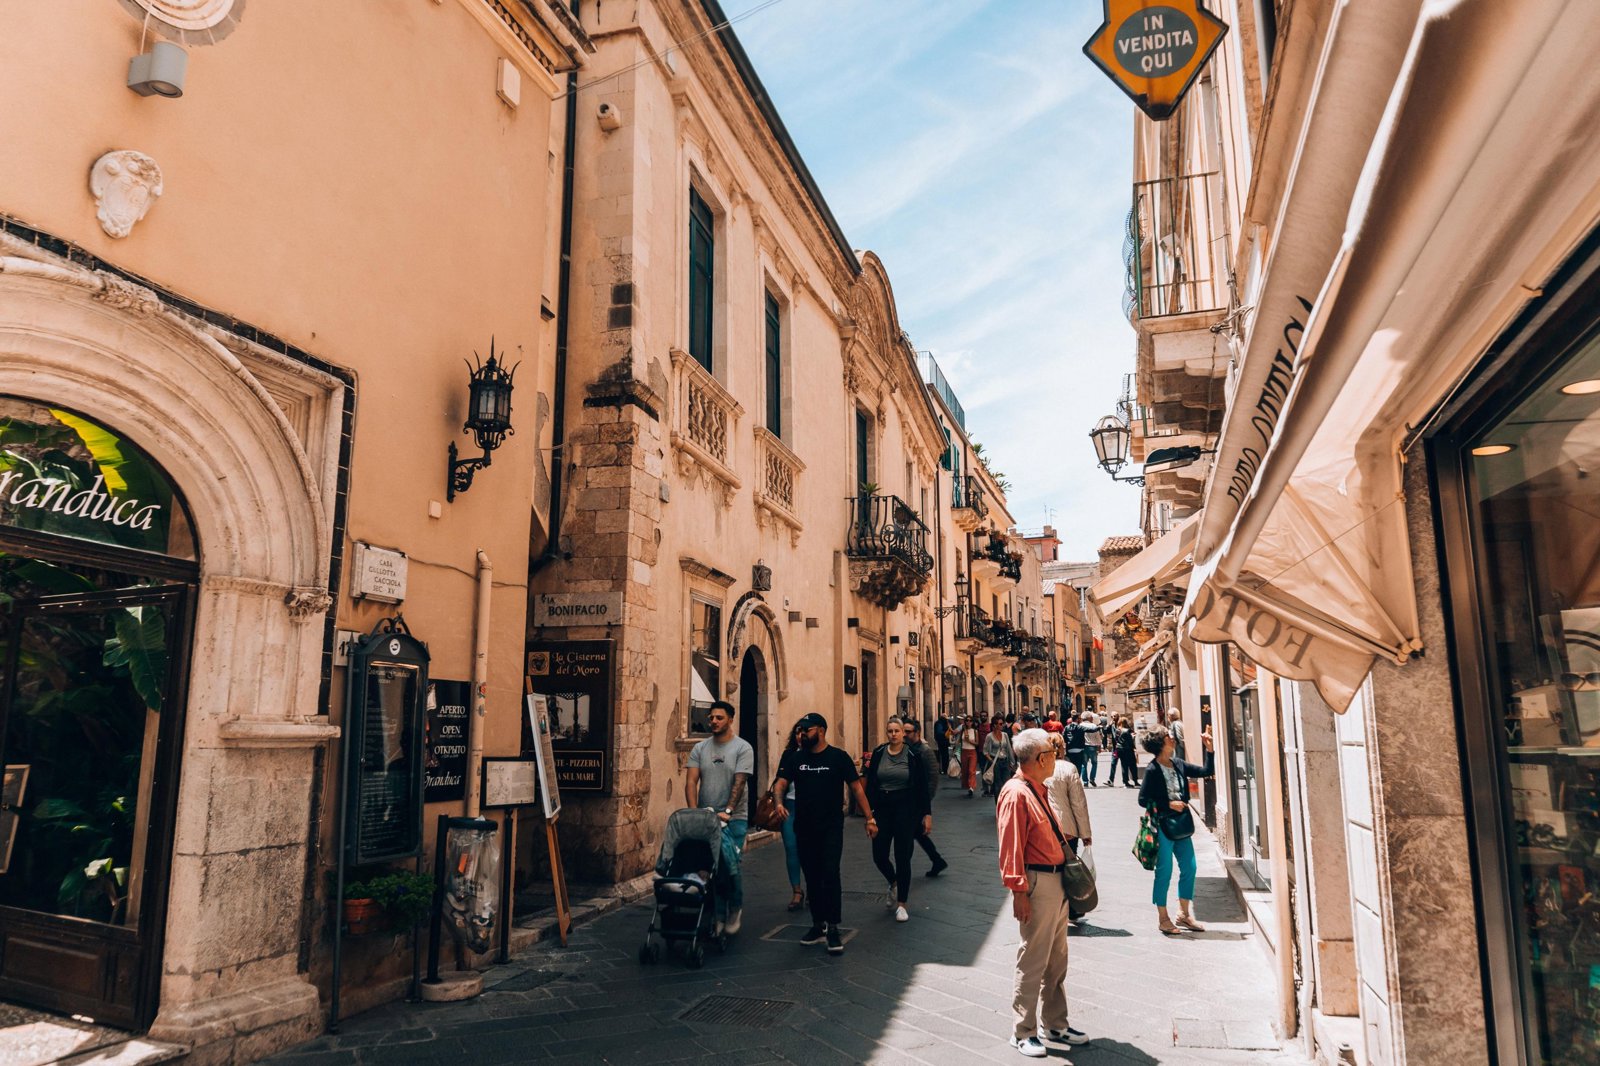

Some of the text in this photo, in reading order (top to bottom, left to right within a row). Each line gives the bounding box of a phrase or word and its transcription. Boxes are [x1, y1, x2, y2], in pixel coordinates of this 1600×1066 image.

[1143, 14, 1164, 31] IN
[1118, 29, 1194, 55] VENDITA
[1141, 51, 1173, 72] QUI
[547, 604, 608, 617] BONIFACIO
[566, 651, 606, 663] Cisterna
[556, 665, 600, 676] del Moro
[439, 705, 466, 715] APERTO
[442, 725, 461, 735] OPEN
[434, 745, 466, 755] ОТКРЫТО
[569, 759, 600, 768] PIZZERIA
[562, 772, 575, 781] SUL
[576, 772, 596, 781] MARE
